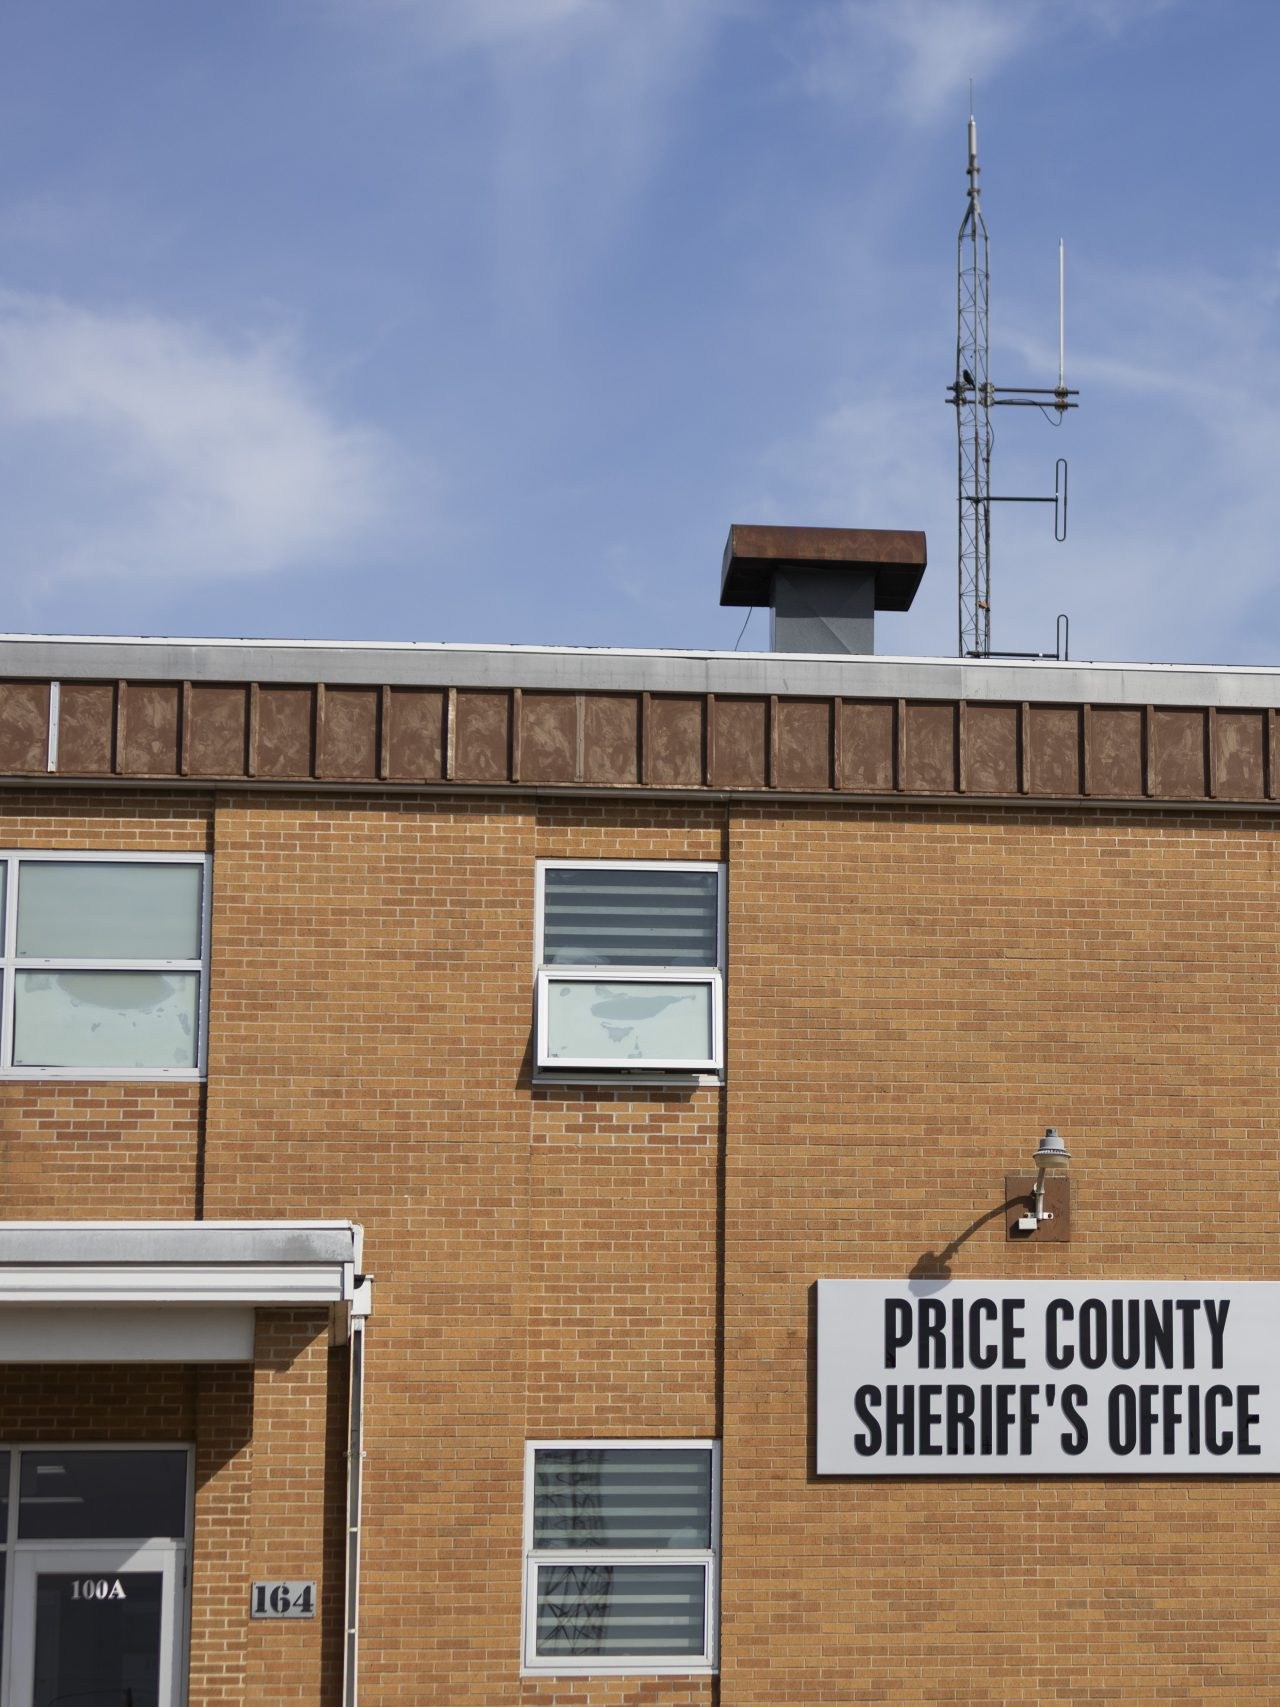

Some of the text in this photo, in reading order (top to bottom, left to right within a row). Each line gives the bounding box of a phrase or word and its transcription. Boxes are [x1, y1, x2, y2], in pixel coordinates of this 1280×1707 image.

[884, 1298, 1231, 1370] PRICE COUNTY
[854, 1383, 1262, 1456] SHERIFF'S OFFICE
[71, 1579, 127, 1600] 100A
[254, 1585, 314, 1613] 164
